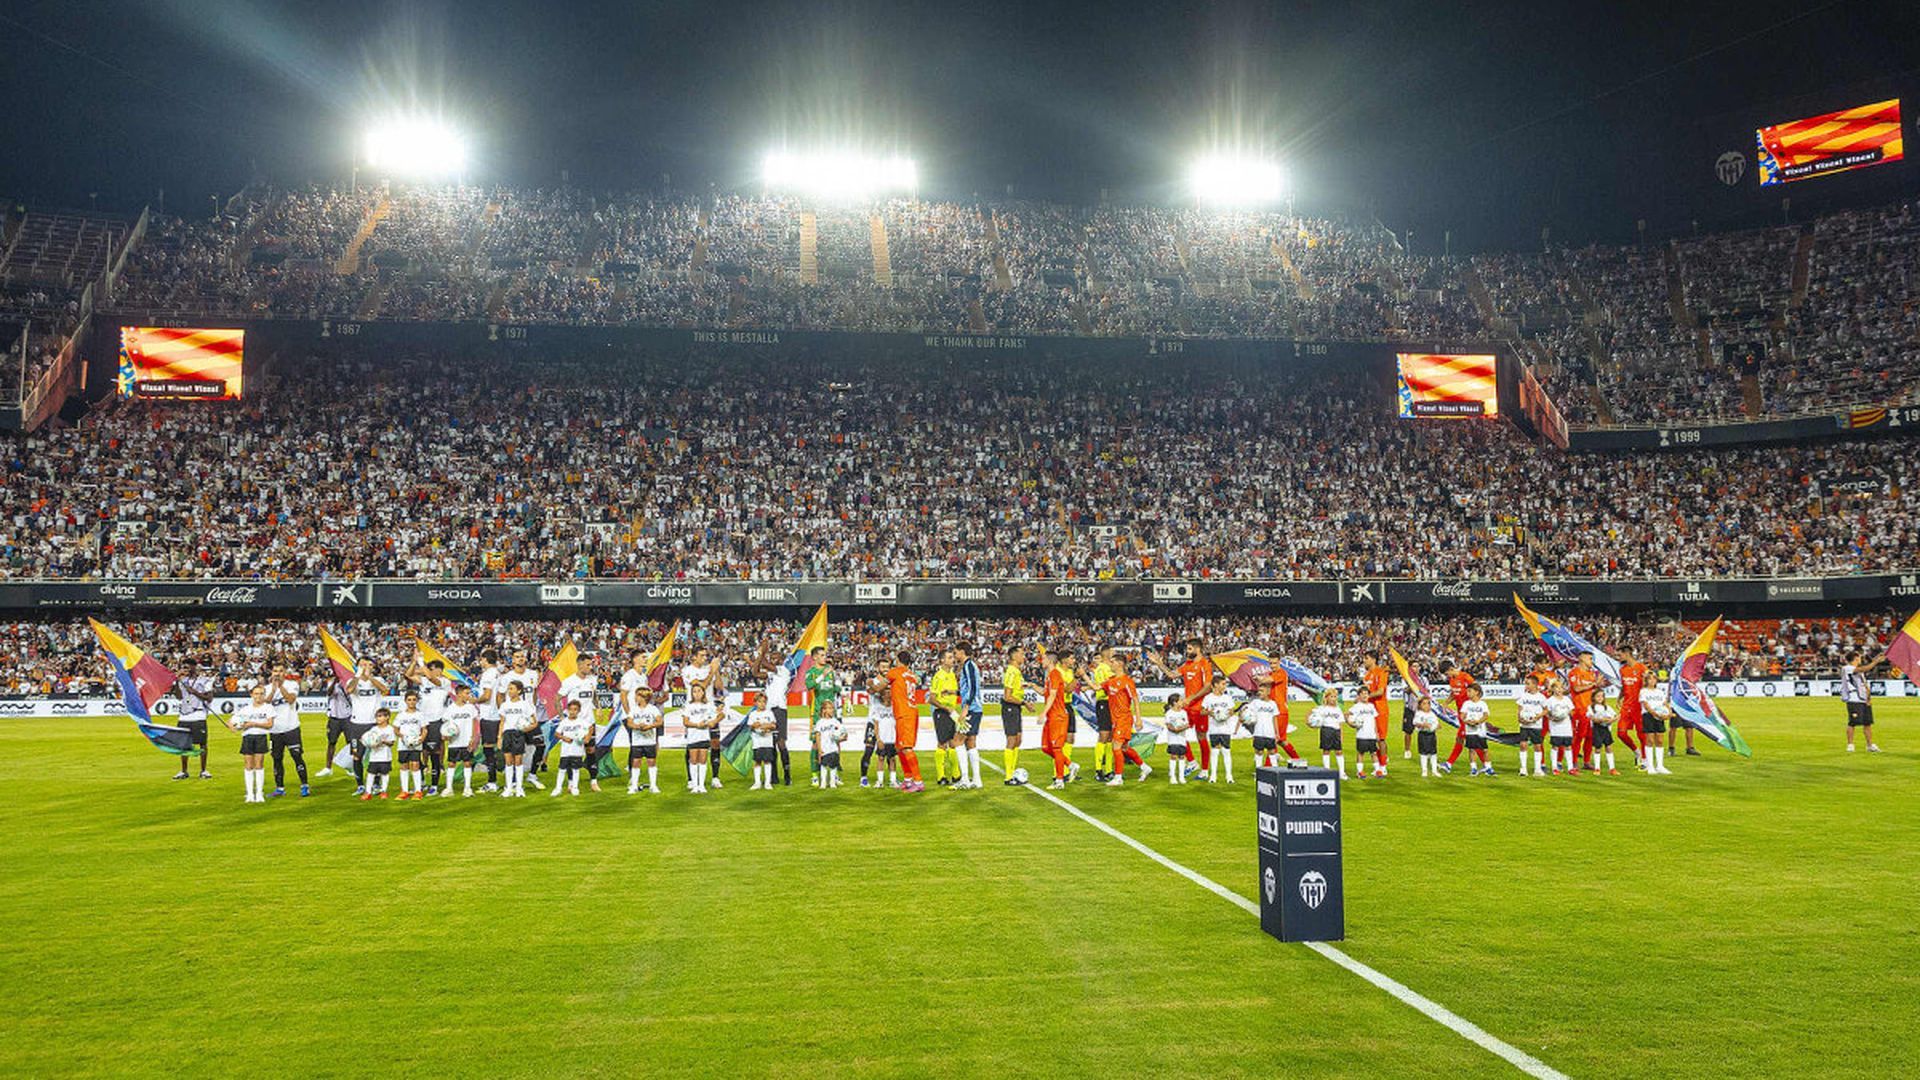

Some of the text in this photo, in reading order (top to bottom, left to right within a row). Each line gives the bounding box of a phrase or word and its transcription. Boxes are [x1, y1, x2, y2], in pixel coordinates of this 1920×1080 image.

[693, 332, 779, 343] THIS IS MESTALLA
[925, 336, 940, 347] WE
[943, 336, 973, 348] THANK
[976, 338, 996, 348] OUR
[1674, 430, 1700, 443] 1999
[100, 584, 136, 595] divina
[544, 588, 560, 598] TM
[647, 584, 691, 598] divina
[748, 588, 785, 600] PUMA
[858, 588, 873, 596] TM
[952, 588, 986, 600] PUMA
[1054, 584, 1096, 597] divina
[1679, 592, 1711, 601] TURIA
[1287, 784, 1306, 796] TM
[1285, 820, 1324, 835] PUMA
